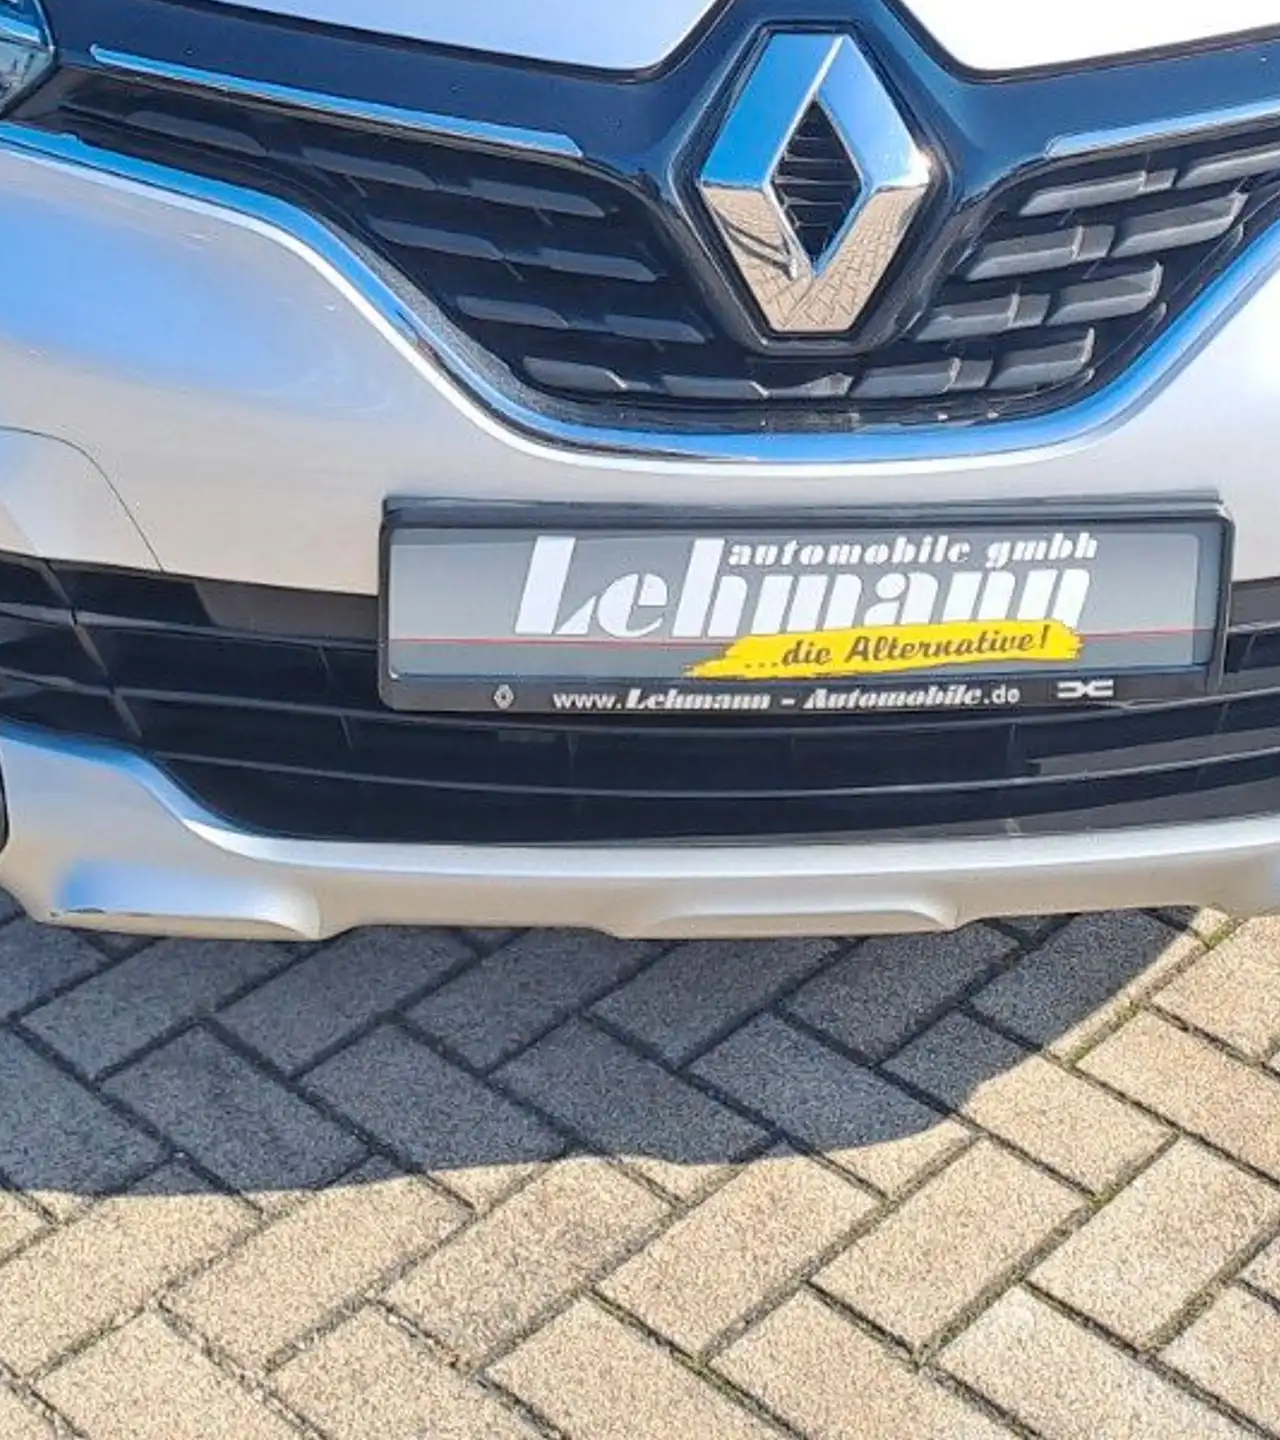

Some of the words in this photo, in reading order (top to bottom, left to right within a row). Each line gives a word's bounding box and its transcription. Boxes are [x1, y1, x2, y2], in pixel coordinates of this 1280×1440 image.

[728, 536, 971, 566] automobile
[985, 531, 1097, 568] gmbh
[515, 535, 1091, 638] Lehmann
[844, 624, 1051, 664] Alternative!
